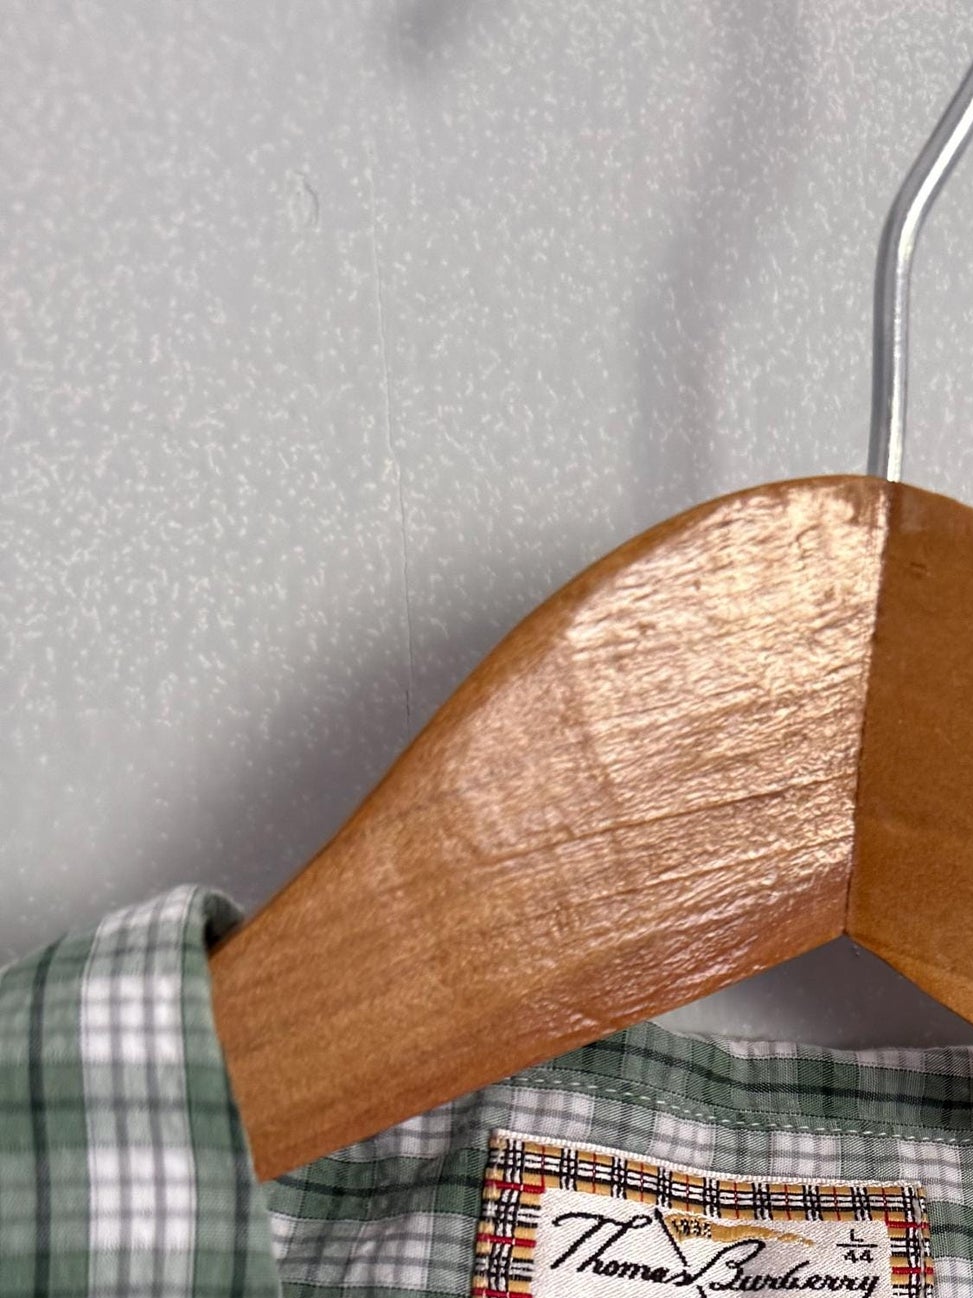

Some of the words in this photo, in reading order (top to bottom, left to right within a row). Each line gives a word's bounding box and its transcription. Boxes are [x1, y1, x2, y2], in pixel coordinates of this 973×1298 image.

[850, 1228, 865, 1242] L
[550, 1210, 695, 1288] Thomas
[843, 1249, 875, 1263] 44
